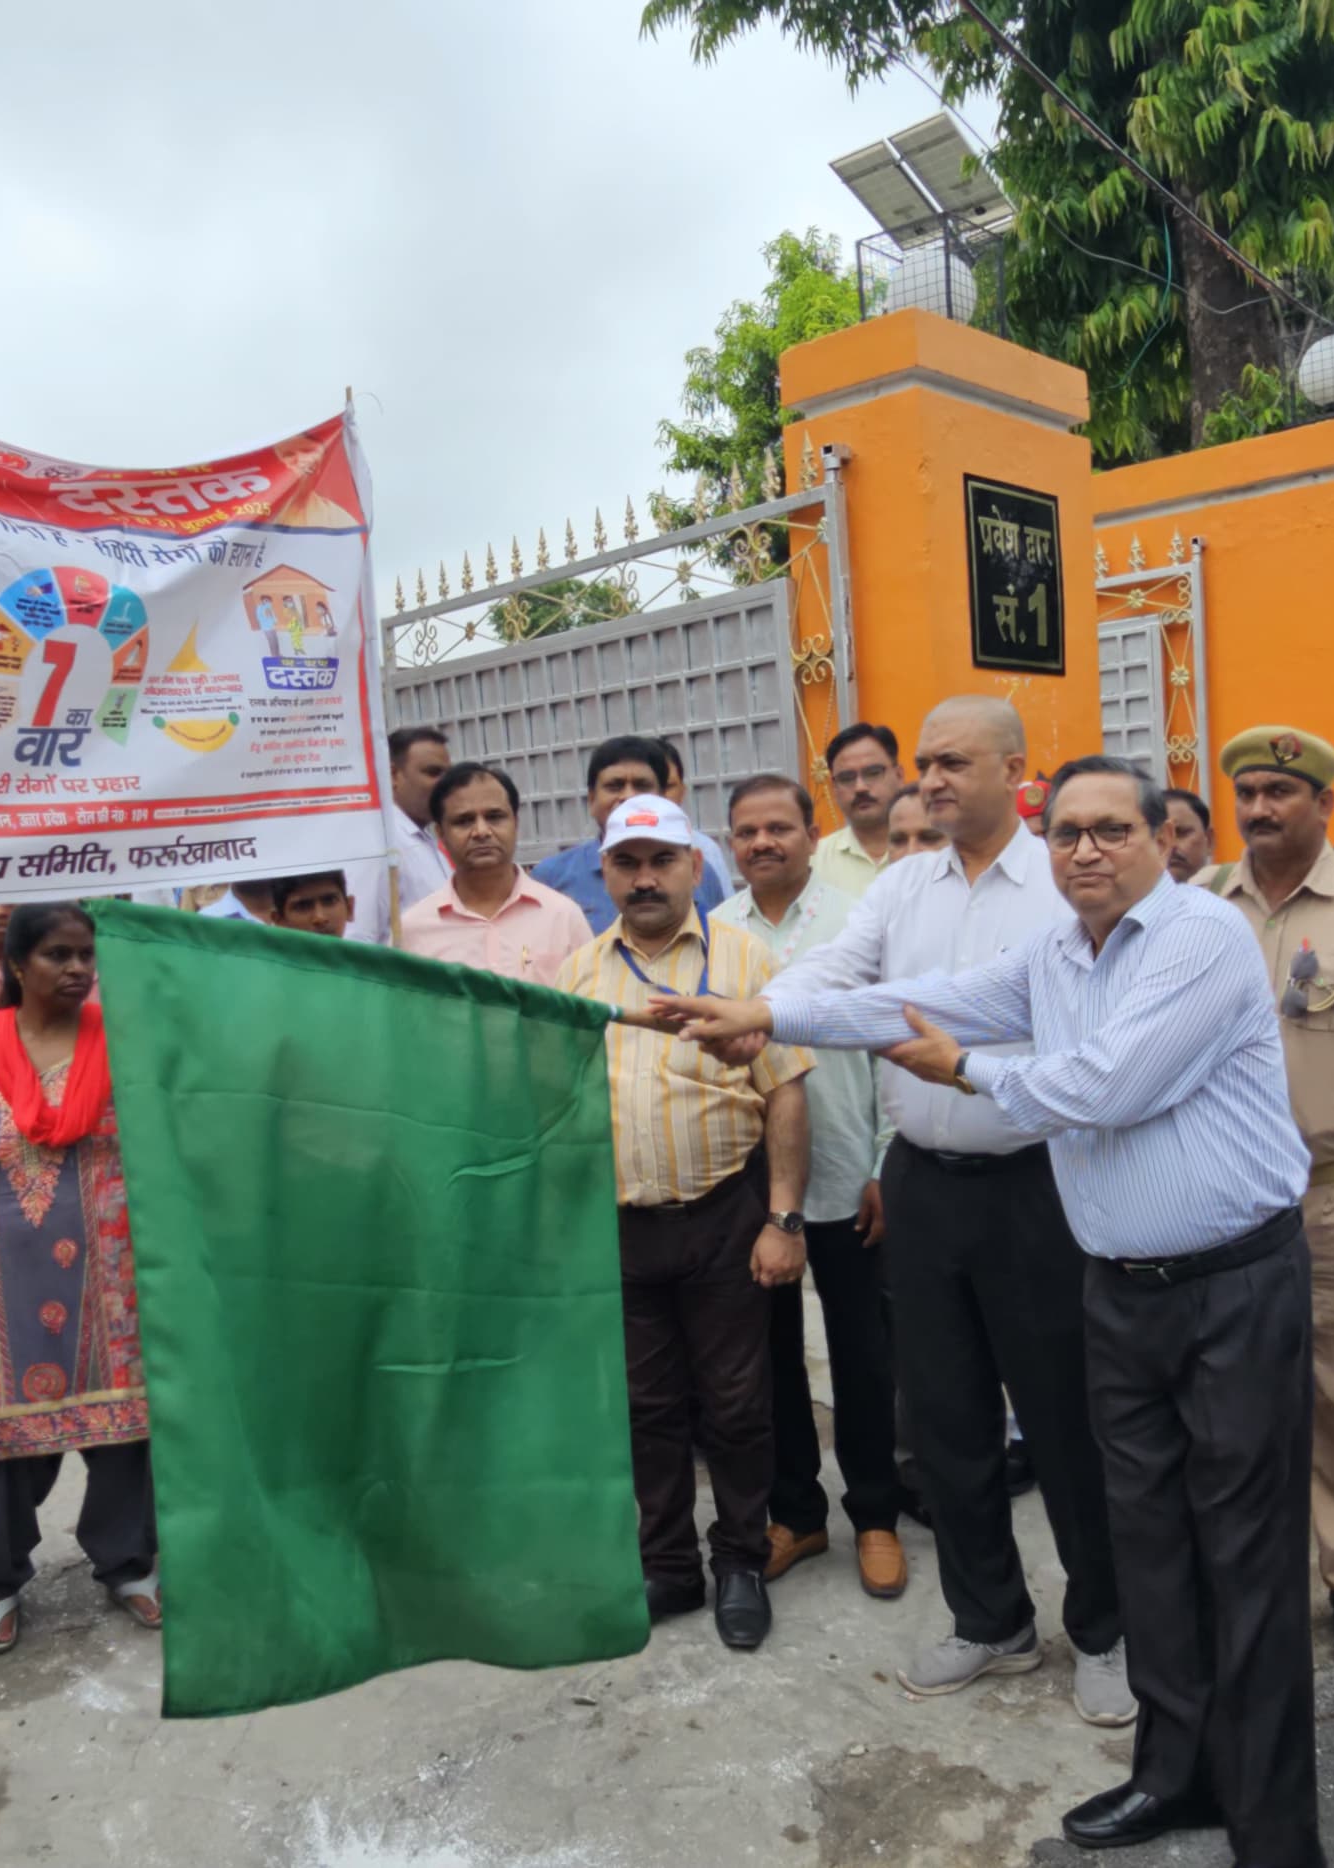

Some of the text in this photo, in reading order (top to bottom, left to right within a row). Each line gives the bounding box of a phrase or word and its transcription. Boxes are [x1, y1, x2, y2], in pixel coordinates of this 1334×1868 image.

[49, 466, 271, 516] दस्तक
[231, 502, 272, 516] 2025
[204, 536, 228, 566] को
[978, 504, 1053, 567] प्रवेश द्वार
[43, 640, 94, 727] 7 का
[267, 667, 337, 688] दस्तक
[14, 727, 92, 767] वार
[15, 774, 58, 795] रोगों
[61, 778, 91, 794] पर
[91, 775, 142, 795] प्रहार
[18, 842, 117, 879] समिति,
